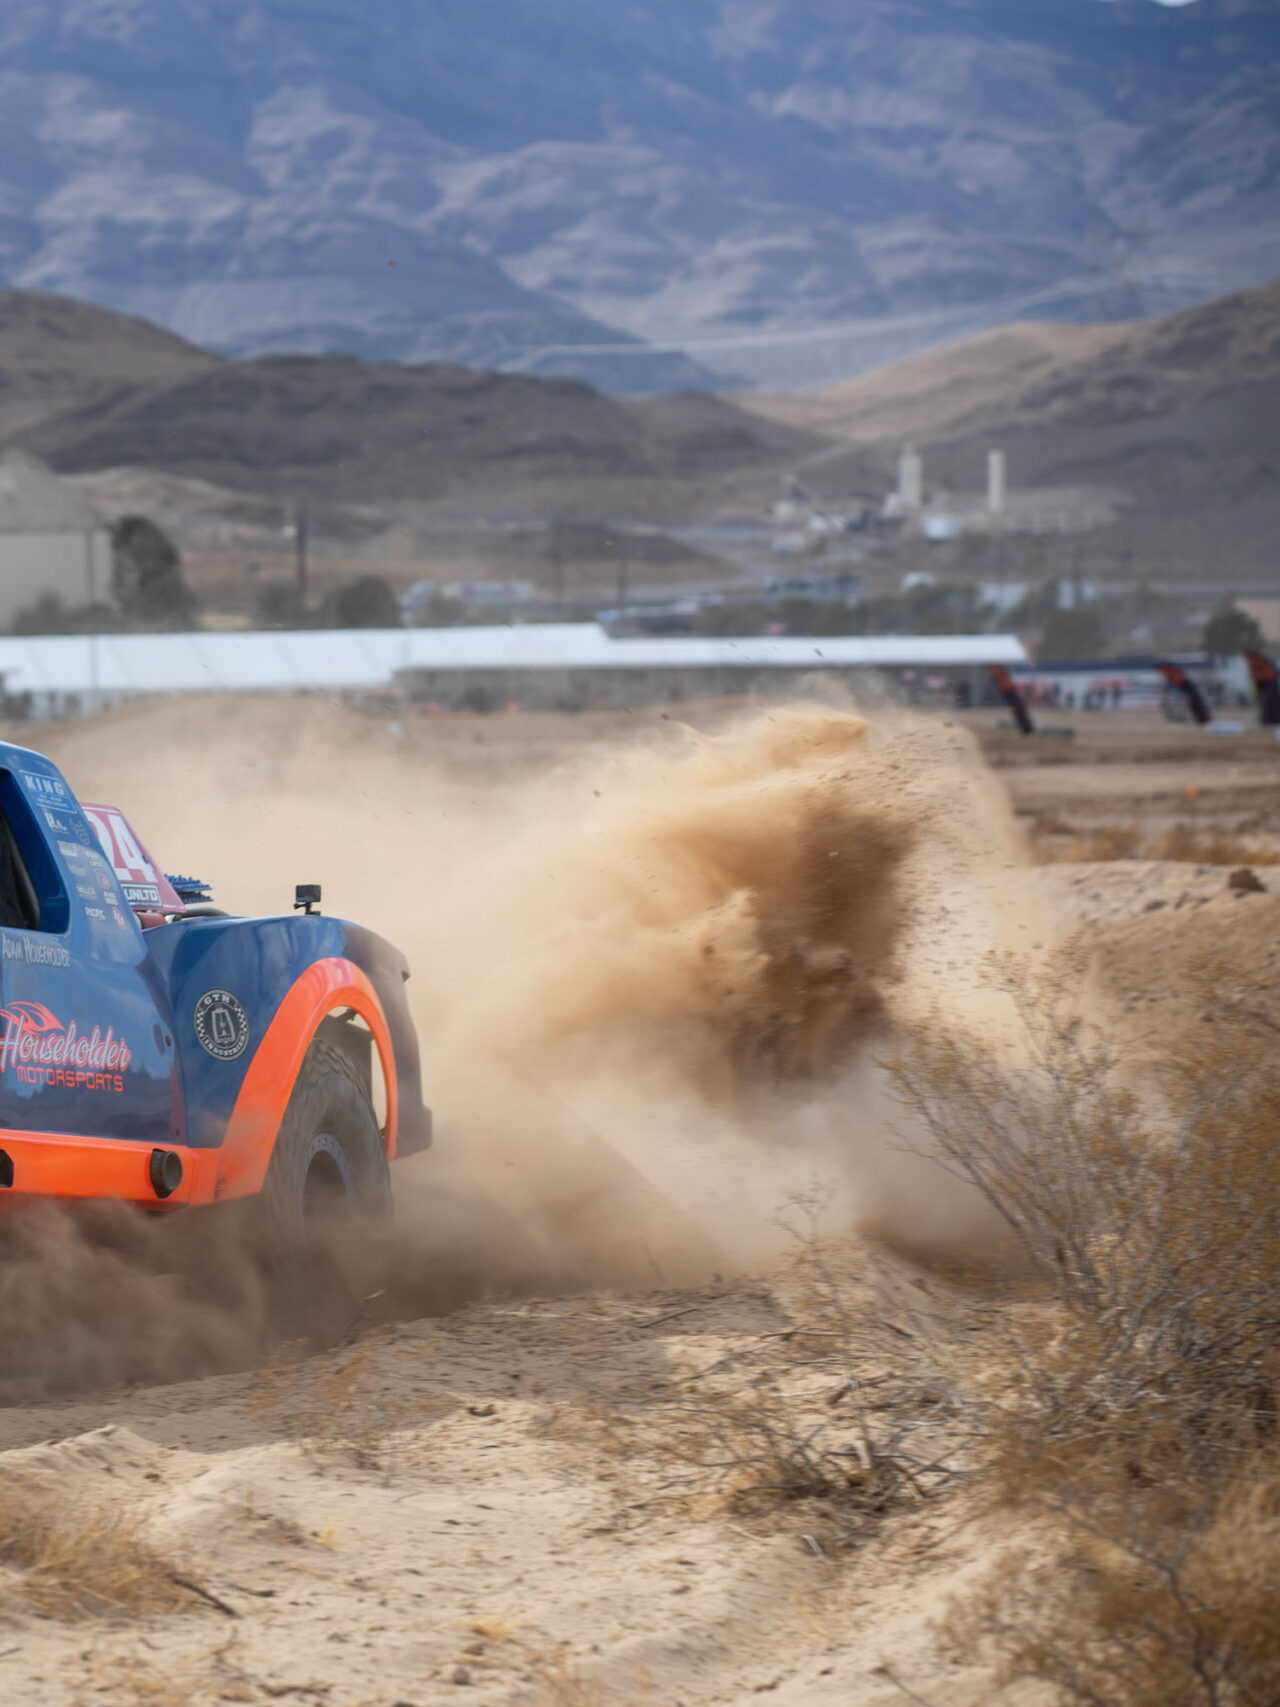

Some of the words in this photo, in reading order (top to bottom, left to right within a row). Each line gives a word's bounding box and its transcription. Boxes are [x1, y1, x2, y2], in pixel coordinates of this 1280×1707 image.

[24, 775, 65, 796] KING
[123, 887, 158, 902] UNLTD
[16, 1065, 124, 1093] MOTORSPORTS
